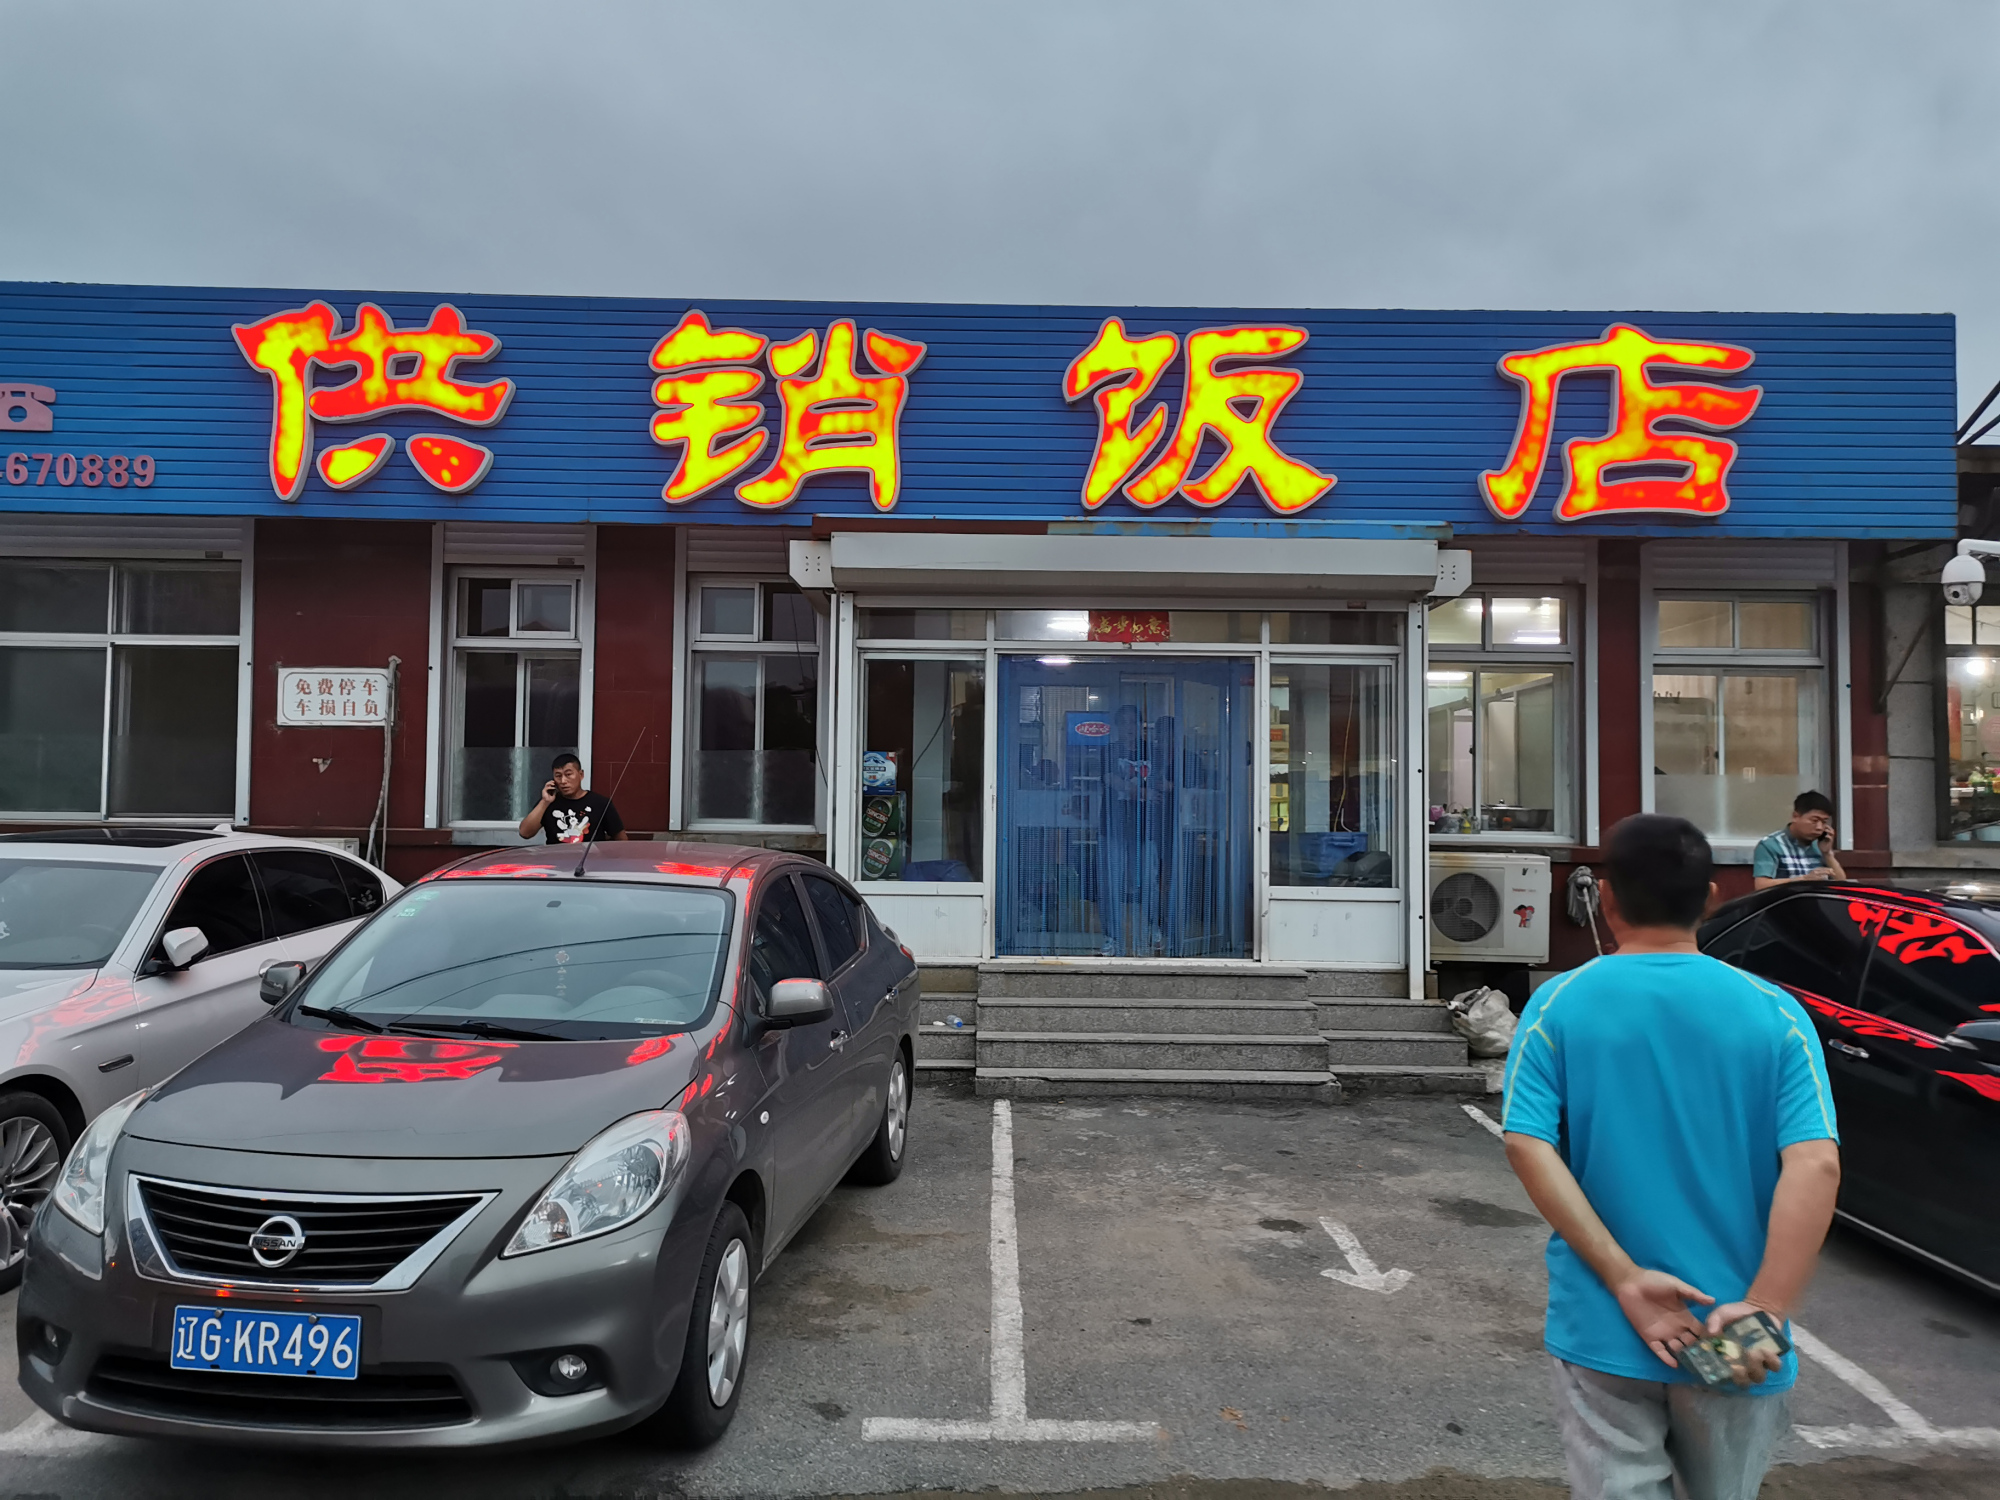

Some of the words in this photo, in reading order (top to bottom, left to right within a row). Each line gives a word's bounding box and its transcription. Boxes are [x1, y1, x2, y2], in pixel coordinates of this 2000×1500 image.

[231, 300, 1763, 521] 供销饭店
[295, 678, 379, 696] 免费停车
[293, 699, 379, 717] 车损自负
[253, 1237, 297, 1248] NISSAN
